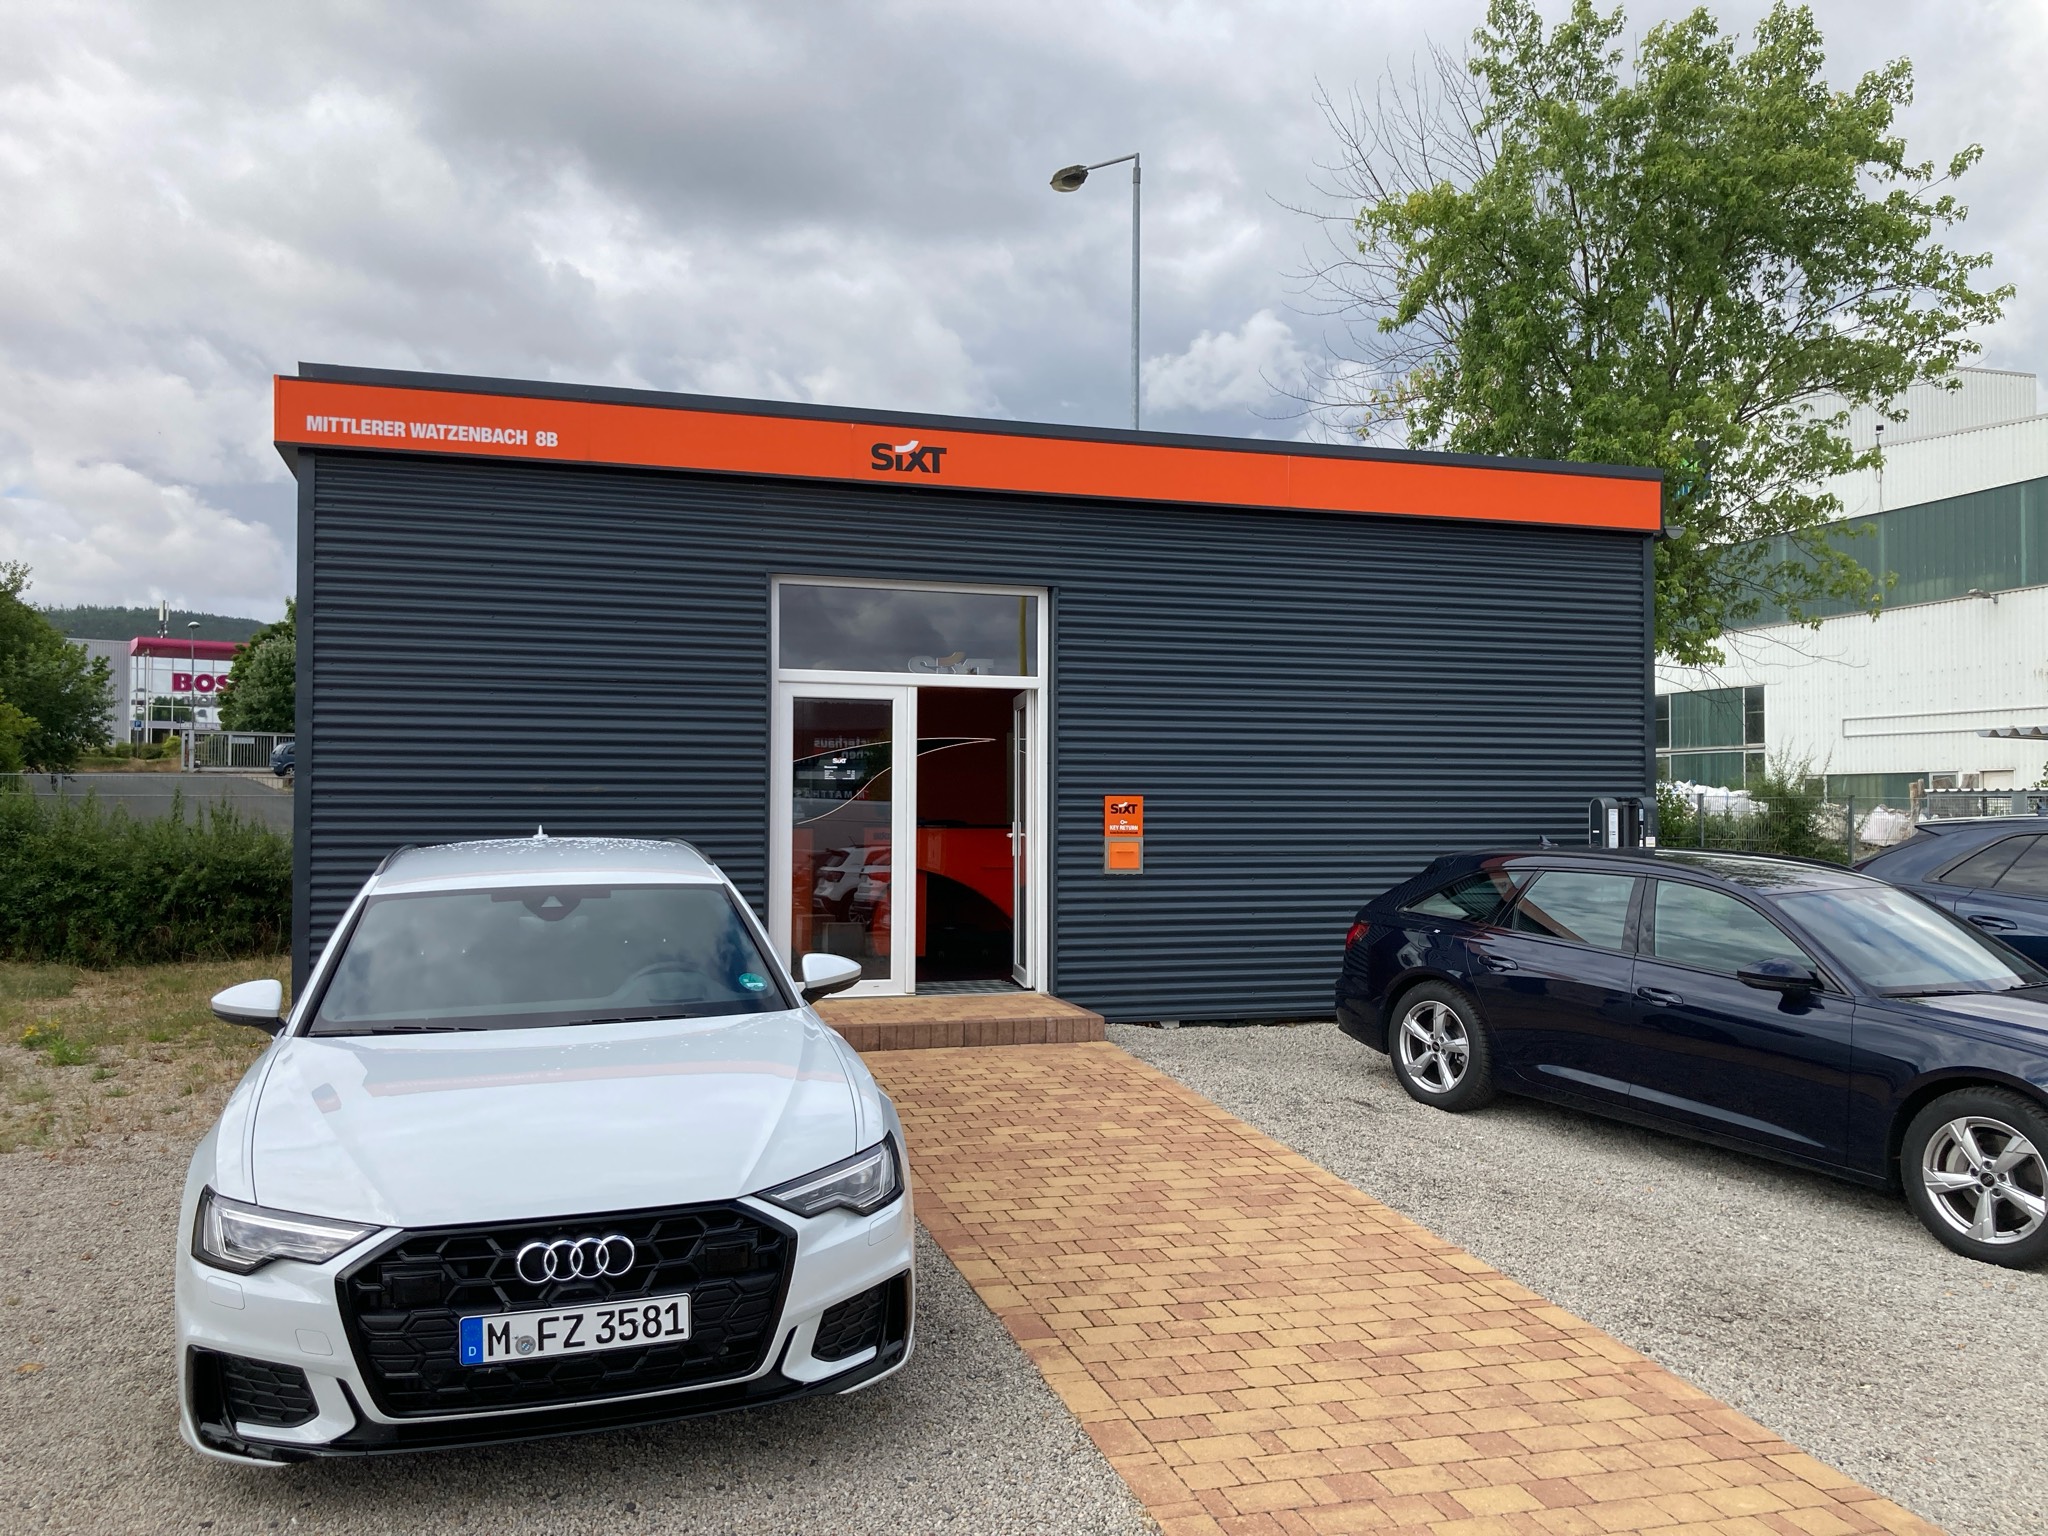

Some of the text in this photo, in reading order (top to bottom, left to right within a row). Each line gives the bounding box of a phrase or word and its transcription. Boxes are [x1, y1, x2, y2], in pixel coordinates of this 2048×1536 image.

[305, 414, 559, 447] MITTLERER WATZENBACH 8B
[871, 440, 948, 473] SIXT
[1110, 802, 1138, 814] SIXT
[487, 1302, 685, 1356] M FZ 3581
[468, 1346, 476, 1356] D
